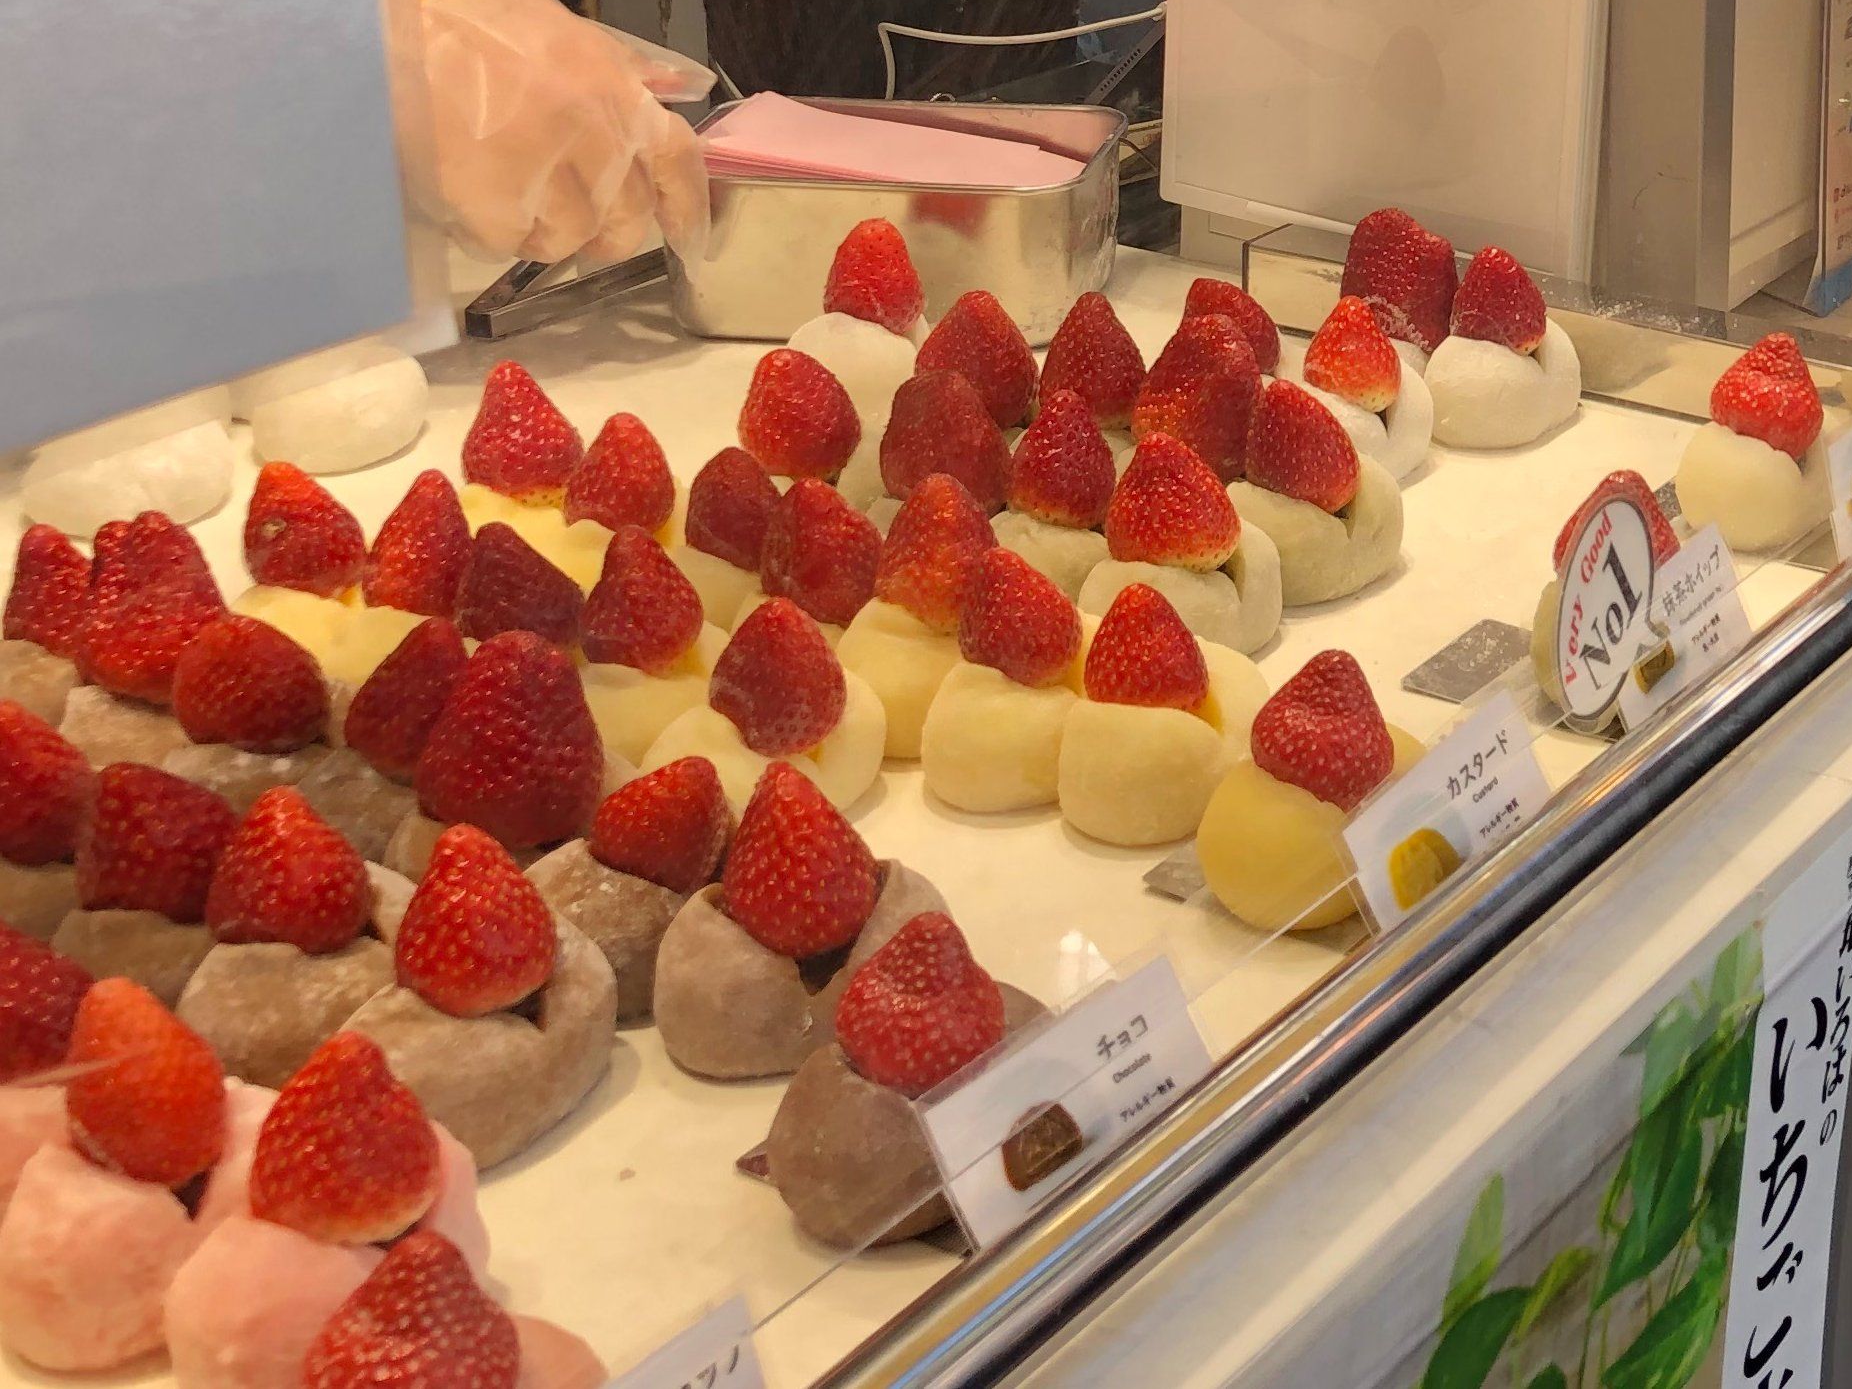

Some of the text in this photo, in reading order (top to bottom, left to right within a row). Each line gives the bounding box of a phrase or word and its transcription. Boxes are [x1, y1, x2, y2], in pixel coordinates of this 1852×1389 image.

[1579, 508, 1613, 584] Good
[1662, 543, 1721, 617] 抹茶ホイップ
[1446, 729, 1508, 800] カスタード
[1096, 1014, 1149, 1060] チョコ
